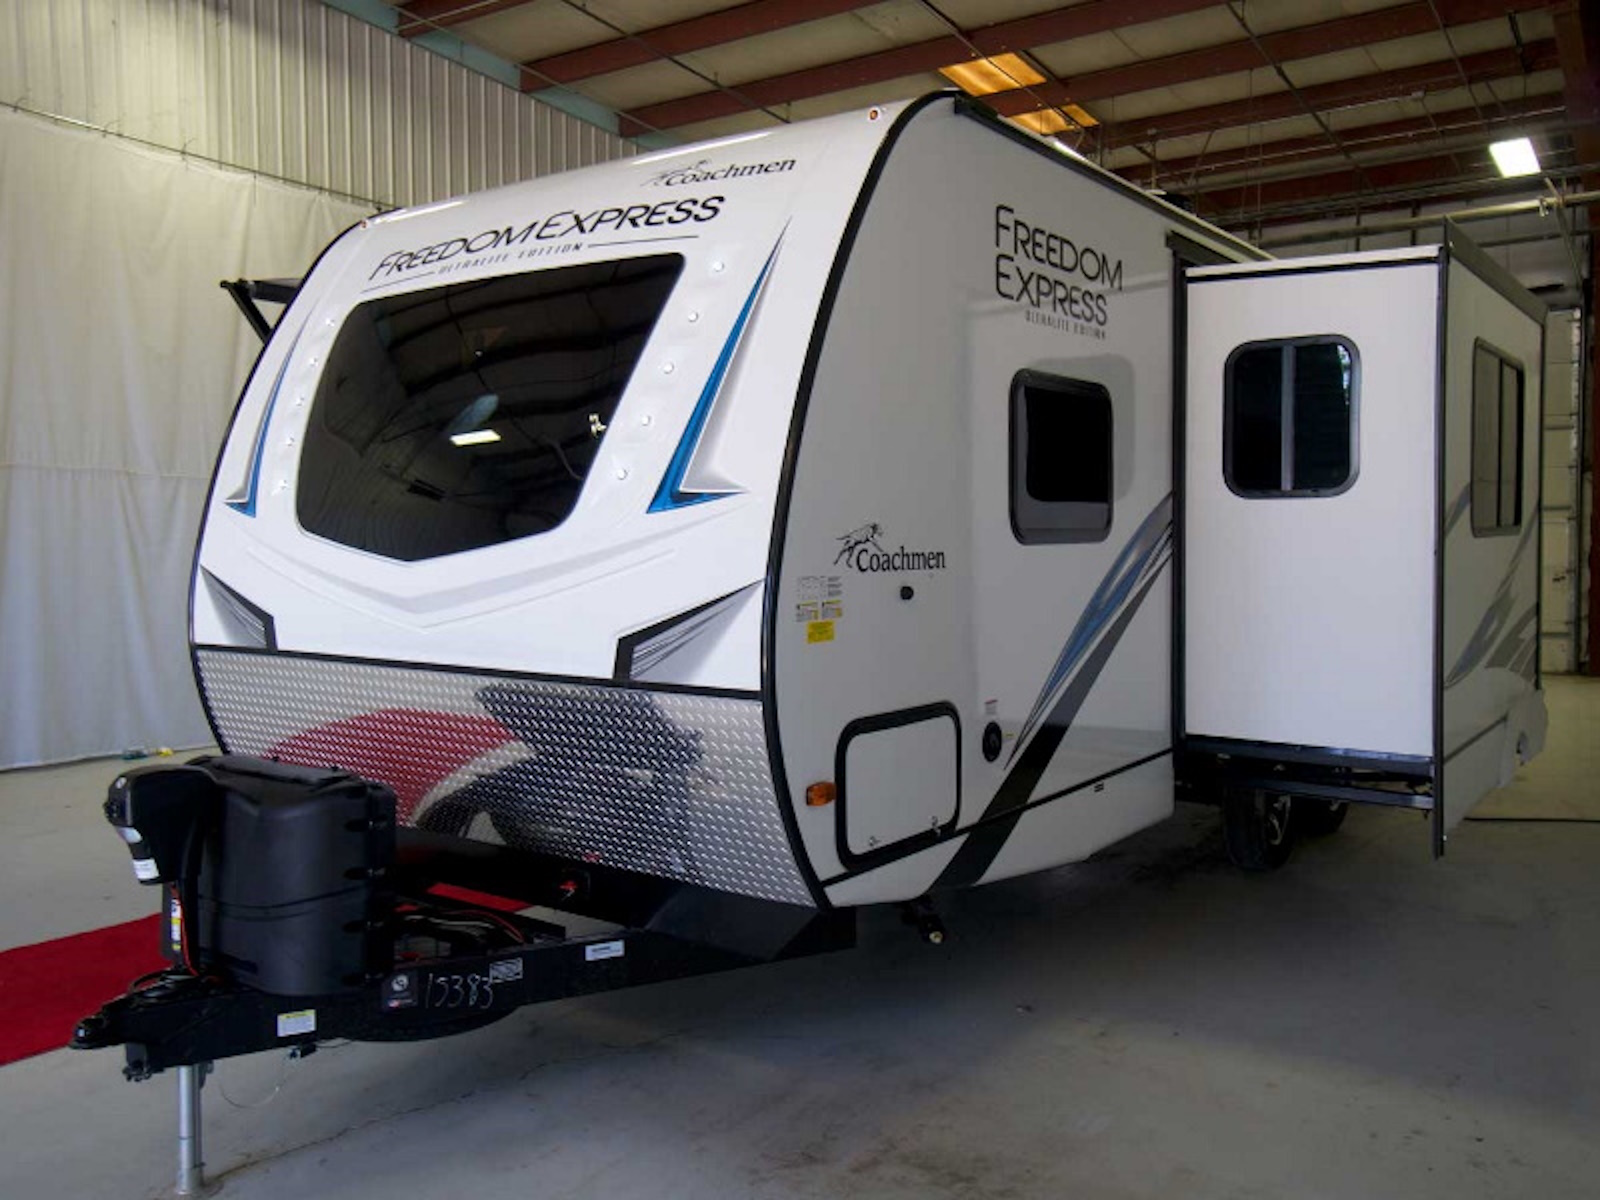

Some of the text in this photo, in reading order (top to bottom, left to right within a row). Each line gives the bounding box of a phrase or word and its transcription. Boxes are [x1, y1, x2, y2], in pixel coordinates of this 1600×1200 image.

[664, 158, 796, 187] Coachmen
[368, 195, 726, 281] FREEDOM EXPRESS
[995, 204, 1123, 292] FREEDOM
[995, 254, 1108, 326] EXPRESS
[856, 545, 946, 572] Coachmen
